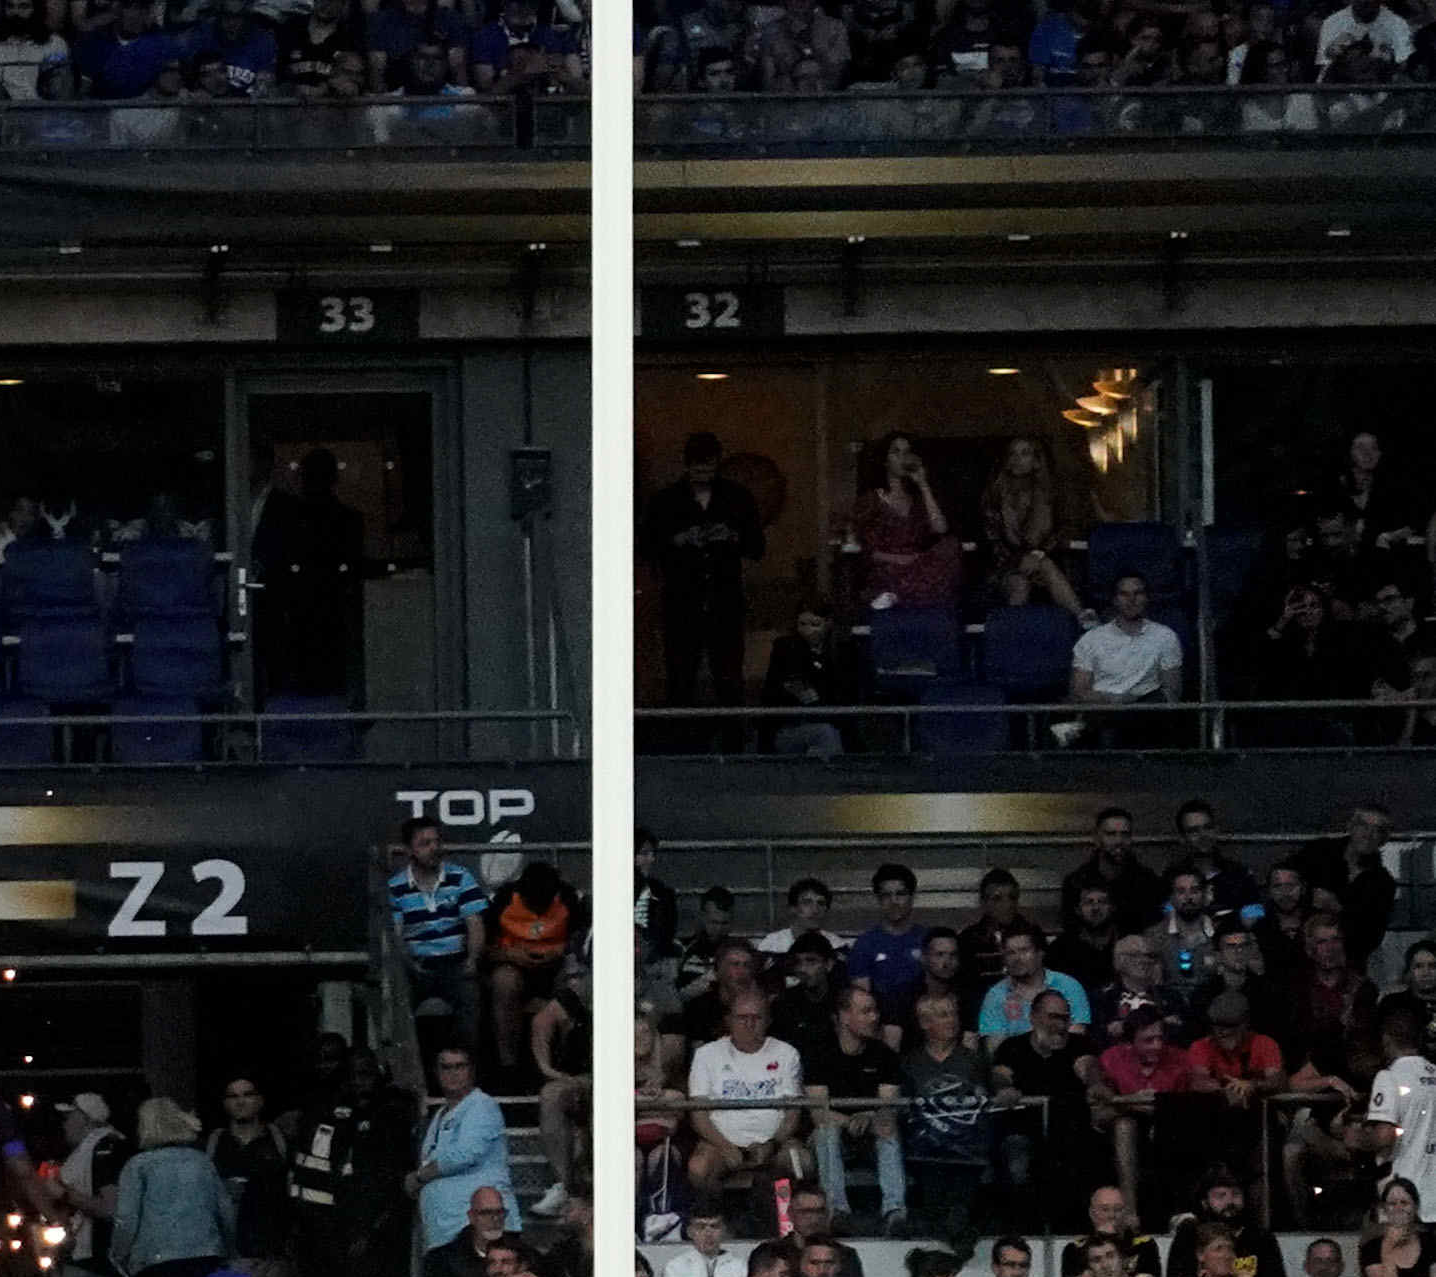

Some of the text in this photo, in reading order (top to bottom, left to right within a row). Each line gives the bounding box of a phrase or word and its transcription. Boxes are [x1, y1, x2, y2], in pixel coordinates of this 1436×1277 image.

[318, 296, 376, 333] 33
[683, 293, 741, 329] 32
[396, 790, 536, 827] TOP
